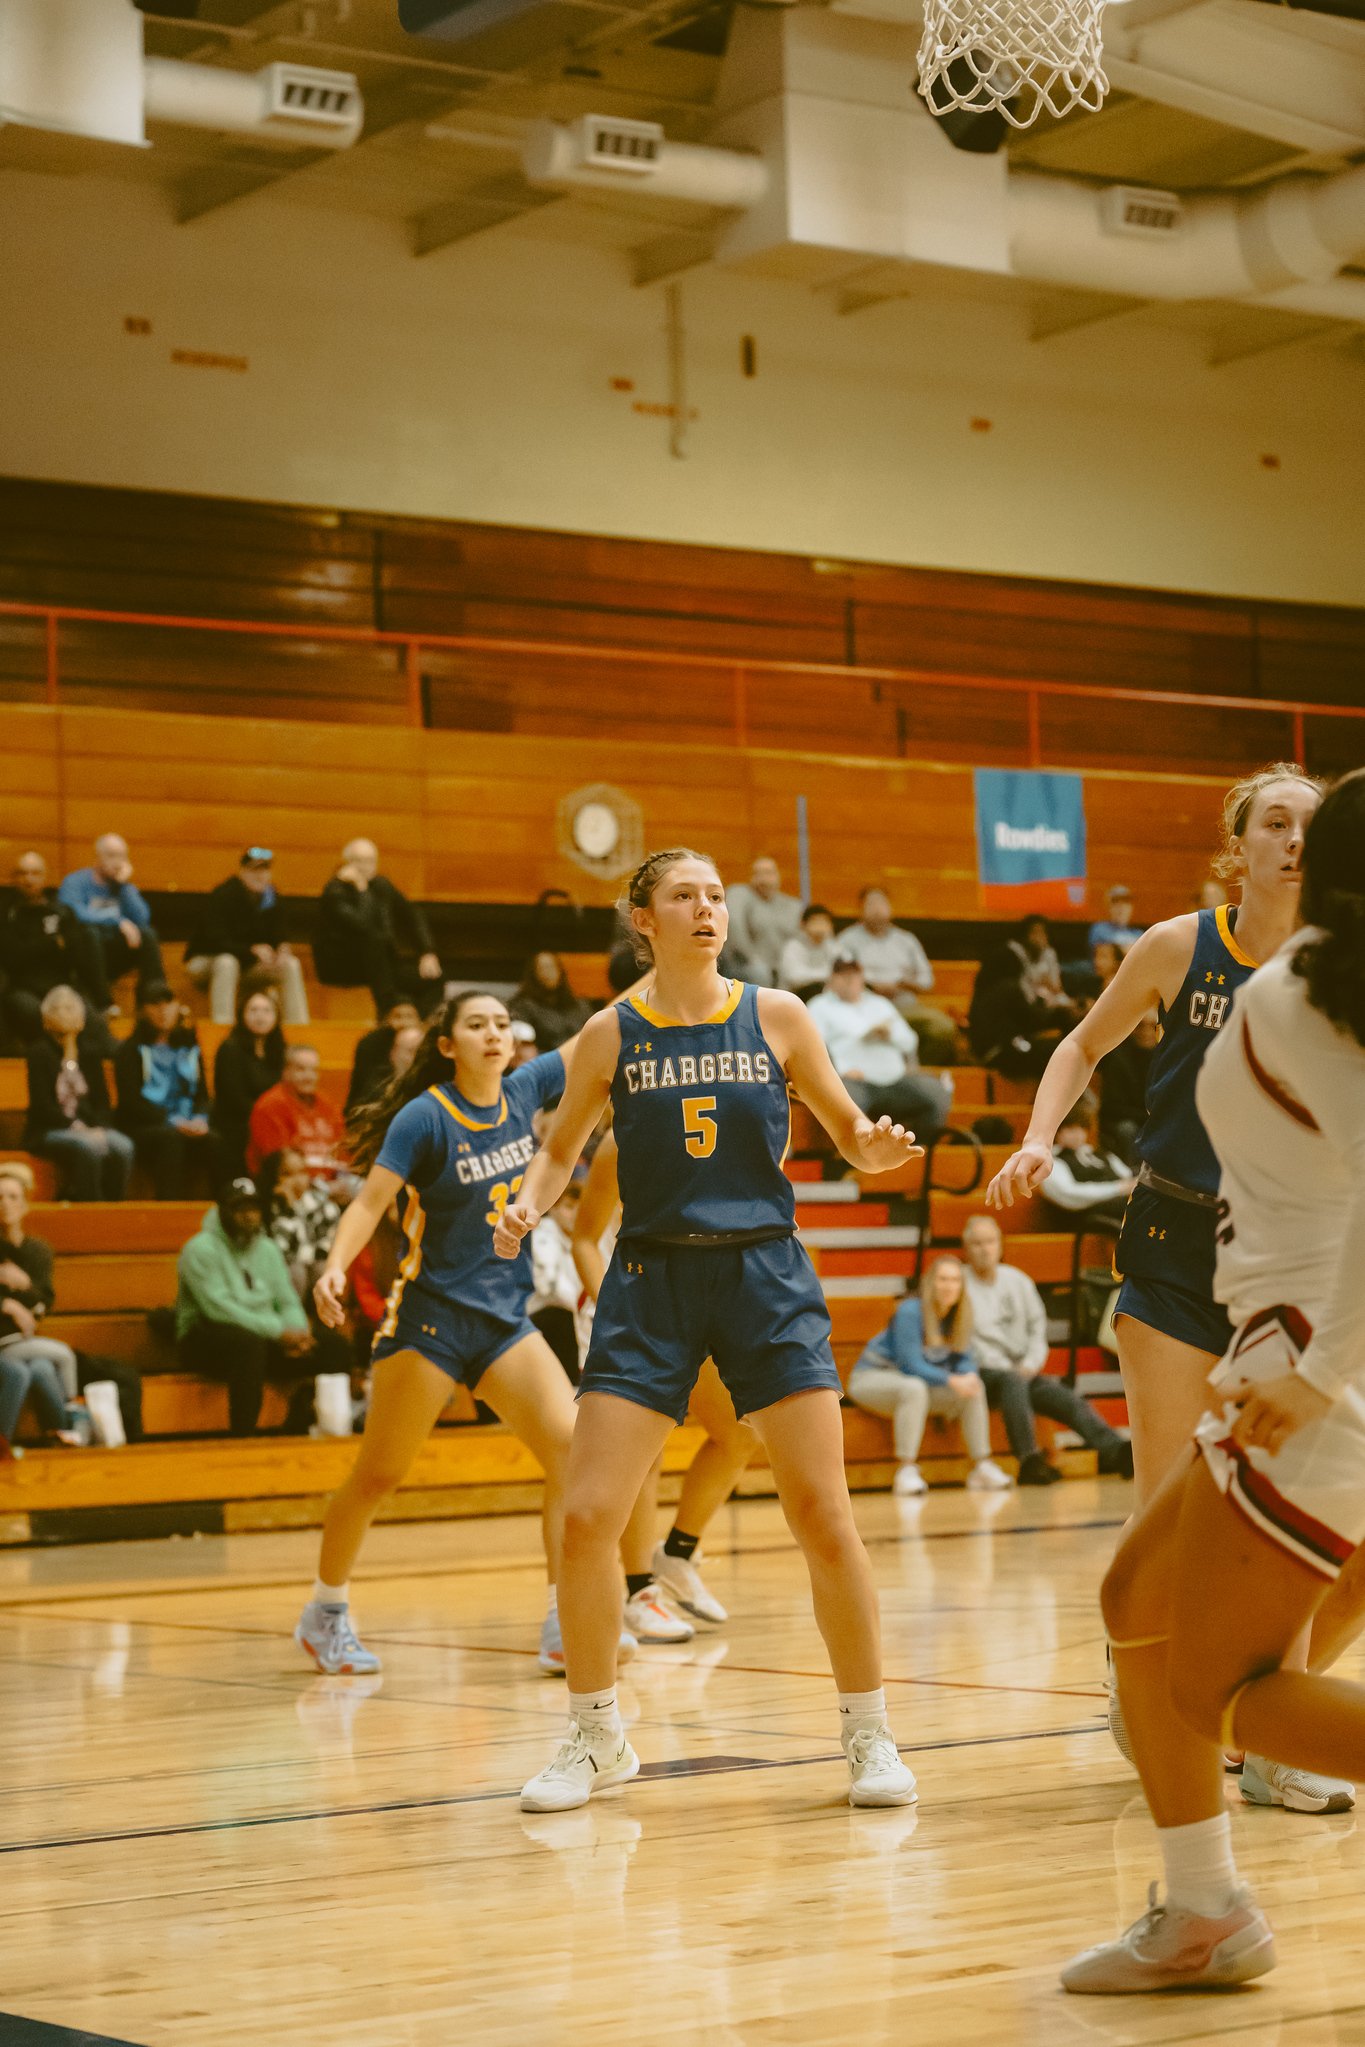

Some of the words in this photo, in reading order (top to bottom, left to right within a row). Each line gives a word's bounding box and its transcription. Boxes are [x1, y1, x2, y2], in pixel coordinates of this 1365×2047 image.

[624, 1051, 771, 1095] CHARGERS
[682, 1096, 717, 1159] 5
[456, 1135, 538, 1184] CHARGER
